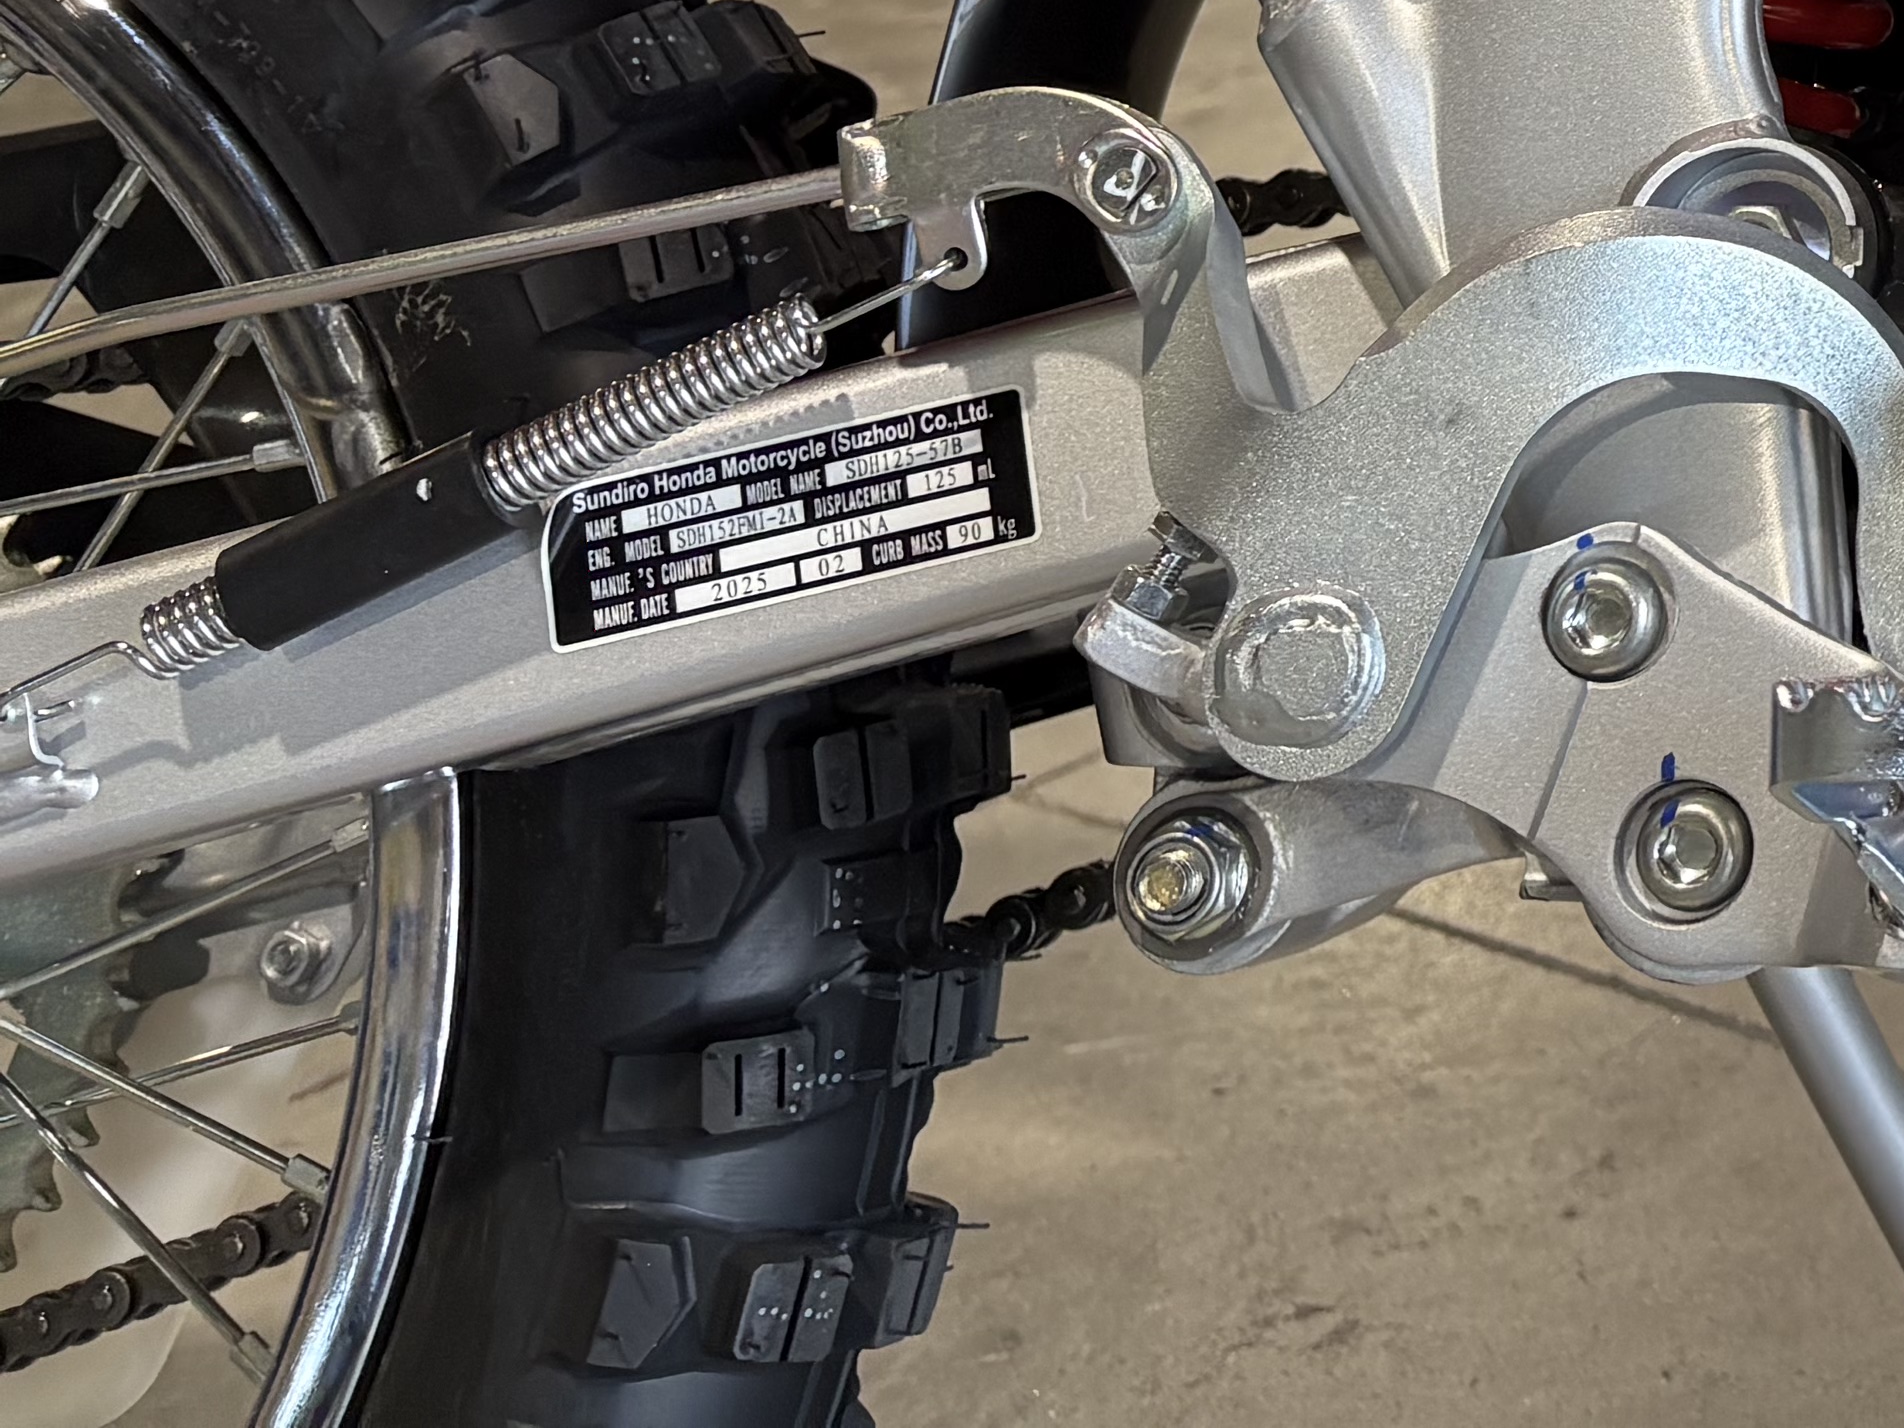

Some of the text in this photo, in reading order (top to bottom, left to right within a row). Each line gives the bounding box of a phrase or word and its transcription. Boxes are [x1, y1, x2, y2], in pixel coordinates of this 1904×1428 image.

[572, 481, 649, 514] Sundiro
[654, 466, 716, 494] Honda
[721, 439, 826, 480] Motorcycle
[831, 414, 915, 457] (Suzhou)
[585, 436, 963, 542] NAME HONDA MODEL NAME SDH125-57B
[588, 546, 615, 572] ENG.
[625, 535, 664, 562] MODEL
[676, 505, 797, 549] SDH152FMI-2A
[814, 479, 903, 519] DISPLACEMENT
[924, 467, 957, 492] 125
[661, 553, 714, 585] COUNTRY
[817, 514, 889, 547] CHINA
[712, 572, 768, 603] 2025
[818, 554, 845, 577] 02
[872, 539, 904, 566] CURB
[911, 529, 943, 556] MASS
[958, 521, 982, 544] 90
[998, 515, 1017, 539] kg
